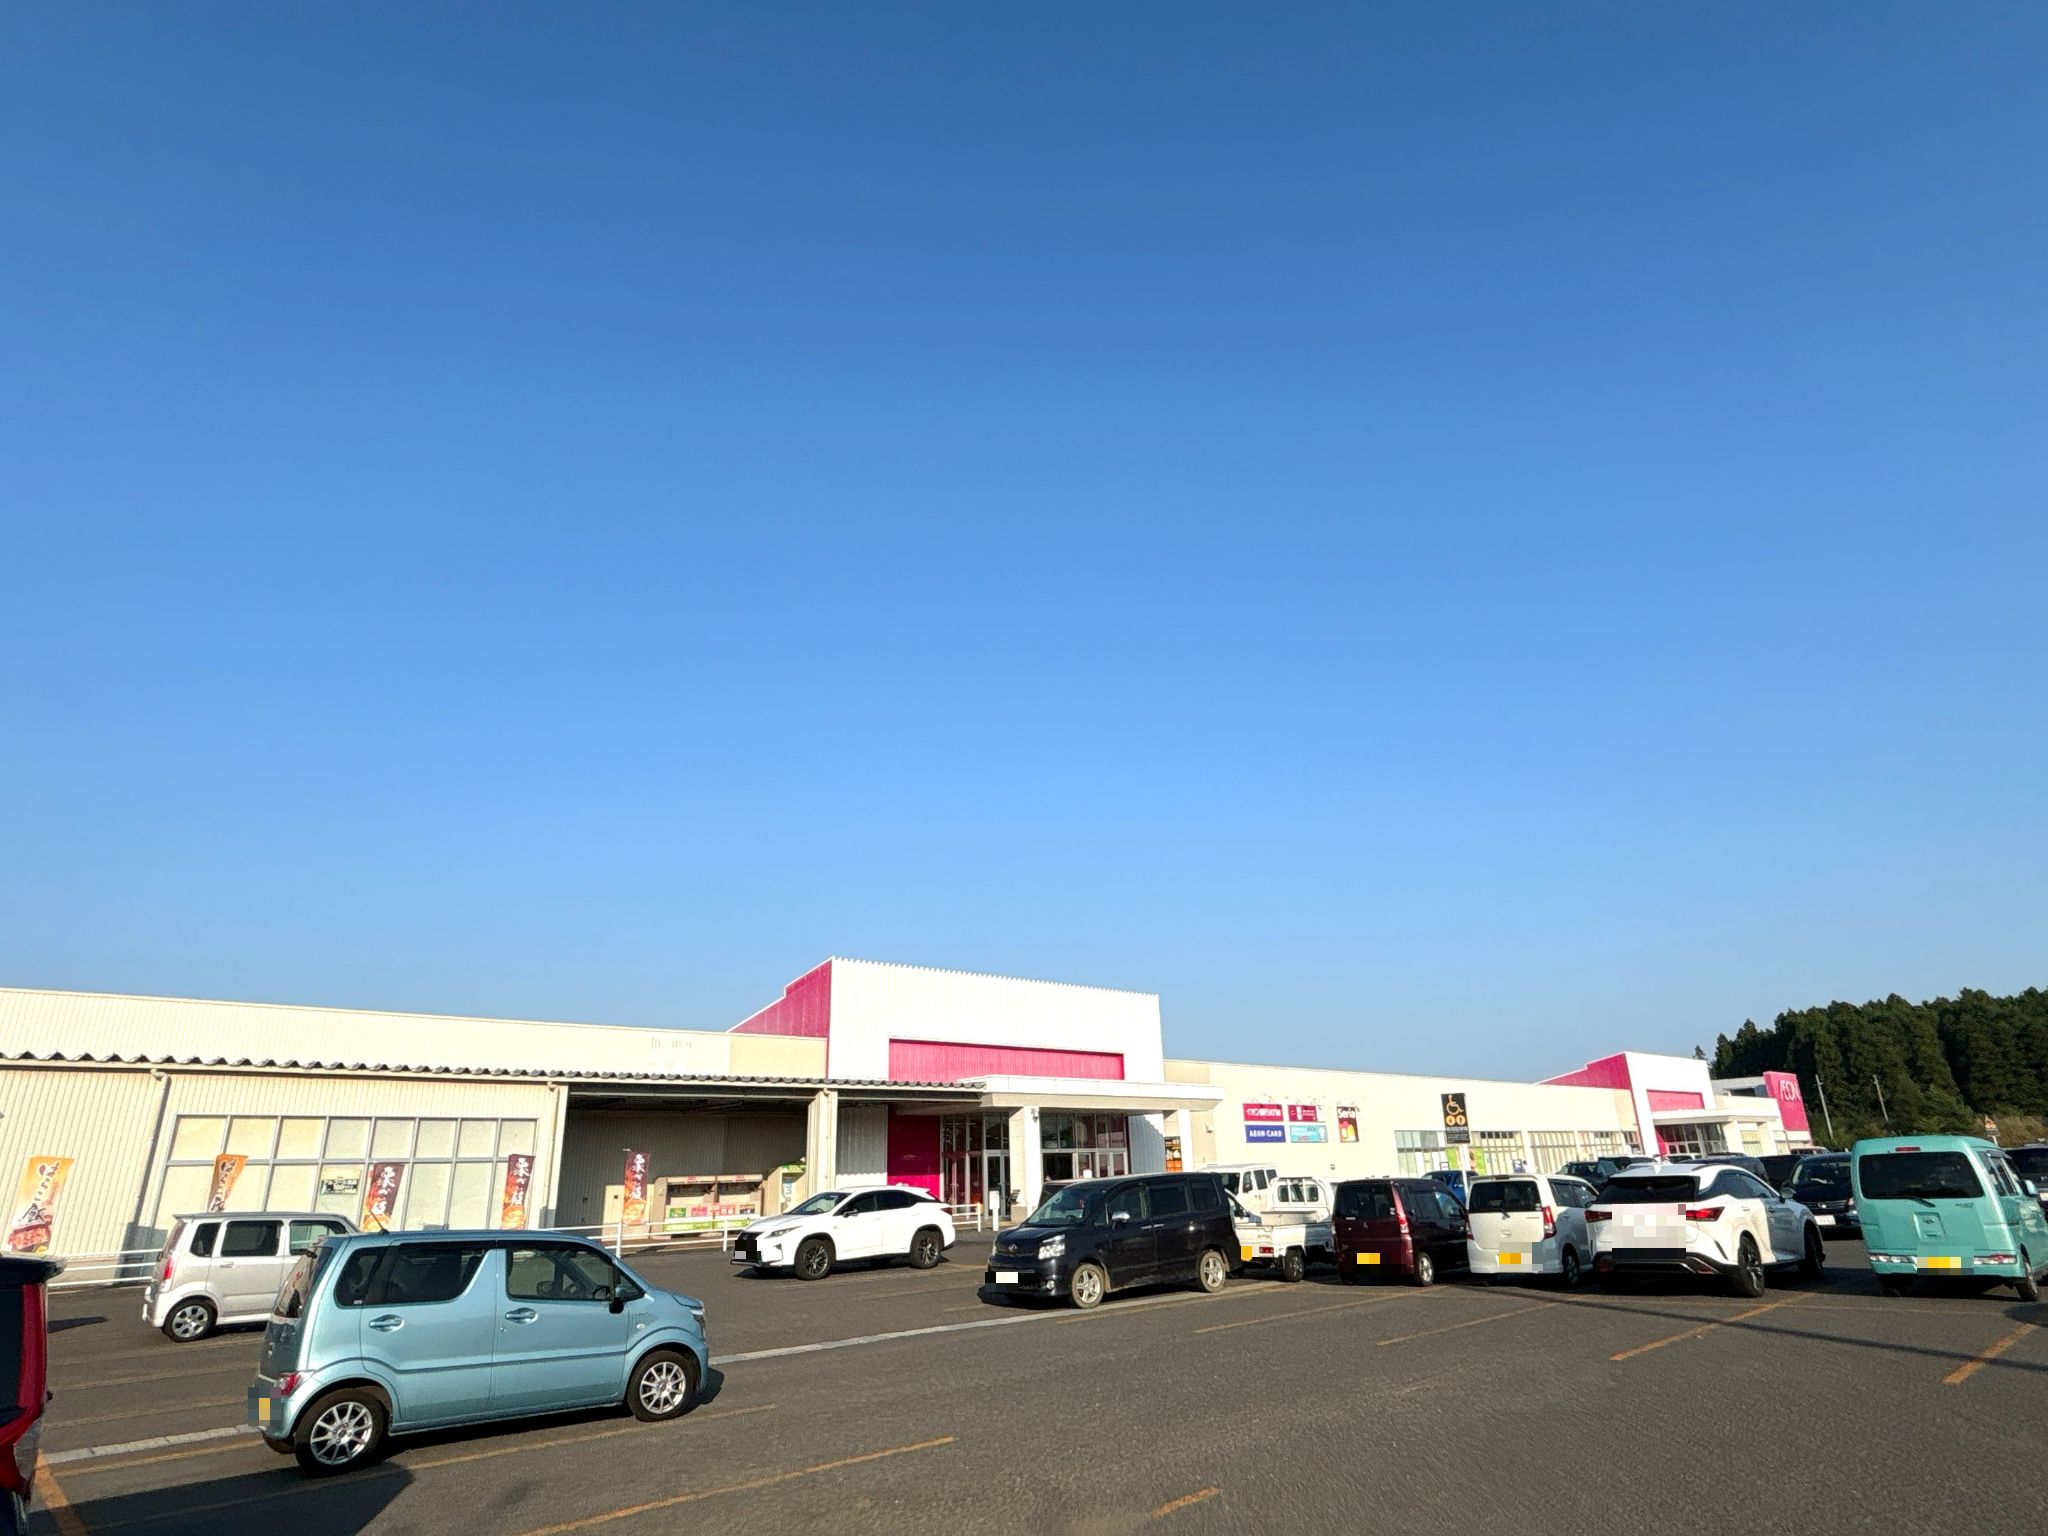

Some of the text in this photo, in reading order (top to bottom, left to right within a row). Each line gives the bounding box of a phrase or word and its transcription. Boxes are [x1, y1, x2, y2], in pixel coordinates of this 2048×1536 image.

[1338, 1107, 1356, 1119] Seria
[1249, 1129, 1266, 1138] AEON
[1266, 1129, 1282, 1138] CARD
[21, 1162, 60, 1223] はらこ飯
